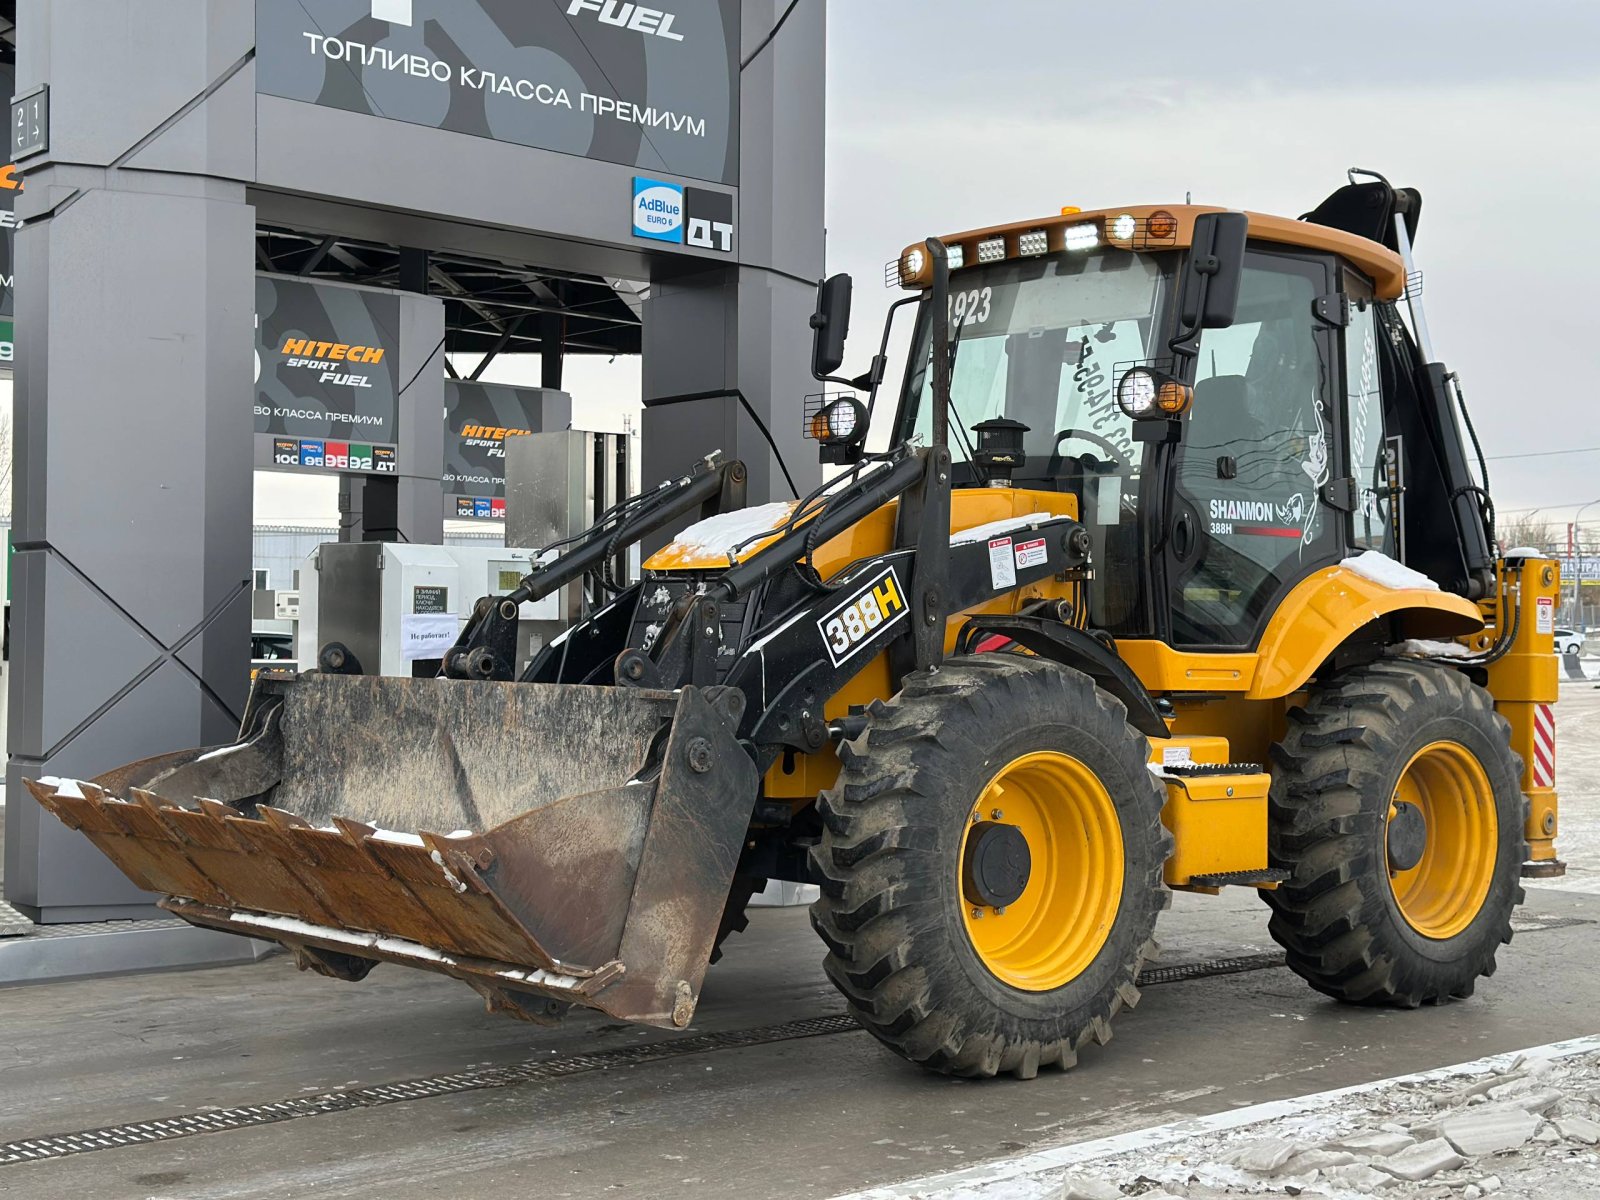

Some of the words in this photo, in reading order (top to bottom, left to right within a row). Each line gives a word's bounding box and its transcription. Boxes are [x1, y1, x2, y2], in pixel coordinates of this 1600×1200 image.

[566, 0, 684, 41] FUEL
[303, 31, 451, 82] ТОПЛИВО
[460, 66, 572, 109] КЛАССА
[580, 92, 705, 137] ПРЕМИУМ
[17, 107, 24, 127] 2
[33, 101, 38, 119] 1
[638, 197, 680, 215] AdBlue
[647, 215, 667, 226] EURO
[668, 218, 673, 226] 6
[687, 217, 733, 251] ДТ
[281, 338, 384, 364] HITECH
[286, 358, 339, 371] SPORT
[319, 372, 372, 387] FUEL
[274, 407, 322, 420] КЛАССА
[325, 412, 383, 425] ПРЕМИУМ
[465, 439, 501, 448] SPORT
[275, 454, 299, 465] 100
[487, 448, 506, 458] FU
[304, 456, 323, 467] 95
[325, 455, 348, 468] 95
[349, 456, 372, 470] 92
[376, 461, 395, 472] ДТ
[456, 475, 490, 483] КЛАССА
[1209, 499, 1273, 522] SHANMON
[1210, 522, 1232, 534] 388H
[826, 576, 902, 654] 388H
[421, 632, 450, 641] работает!
